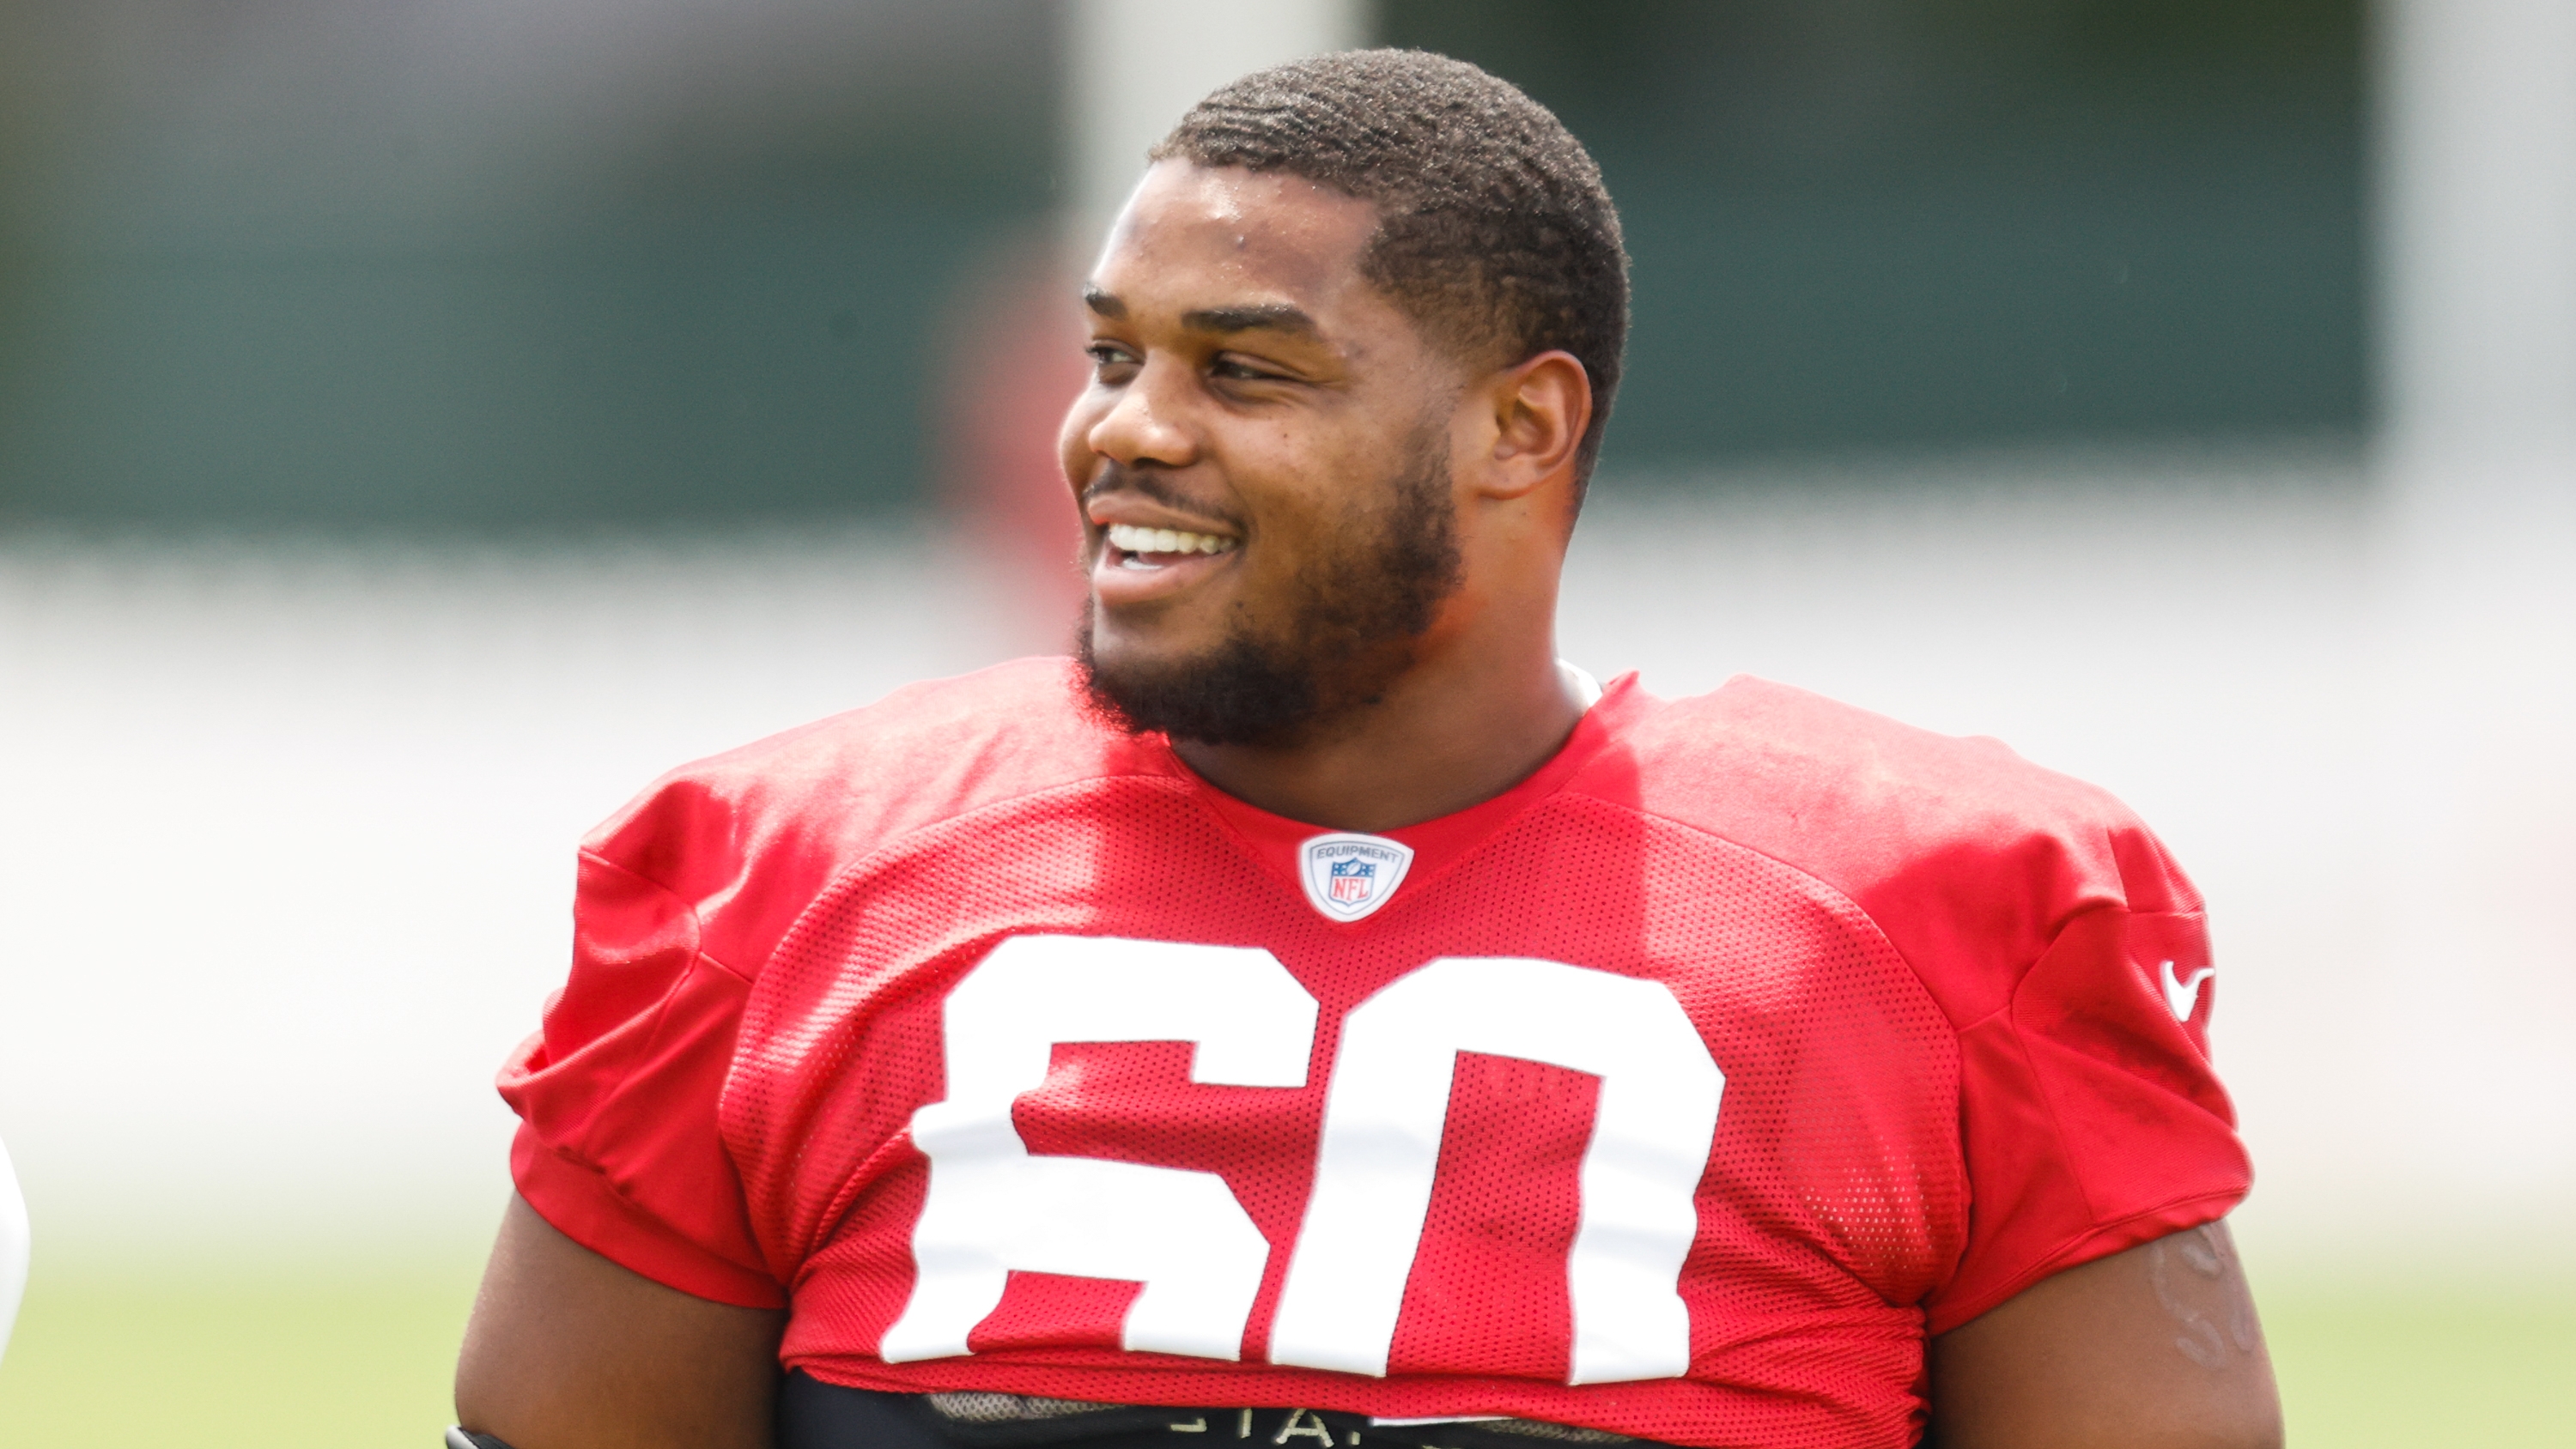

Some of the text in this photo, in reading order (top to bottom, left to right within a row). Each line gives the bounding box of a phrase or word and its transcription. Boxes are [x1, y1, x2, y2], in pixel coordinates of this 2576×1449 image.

[1316, 845, 1399, 864] EQUIPMENT
[1333, 877, 1369, 901] NFL
[879, 934, 1726, 1385] 60
